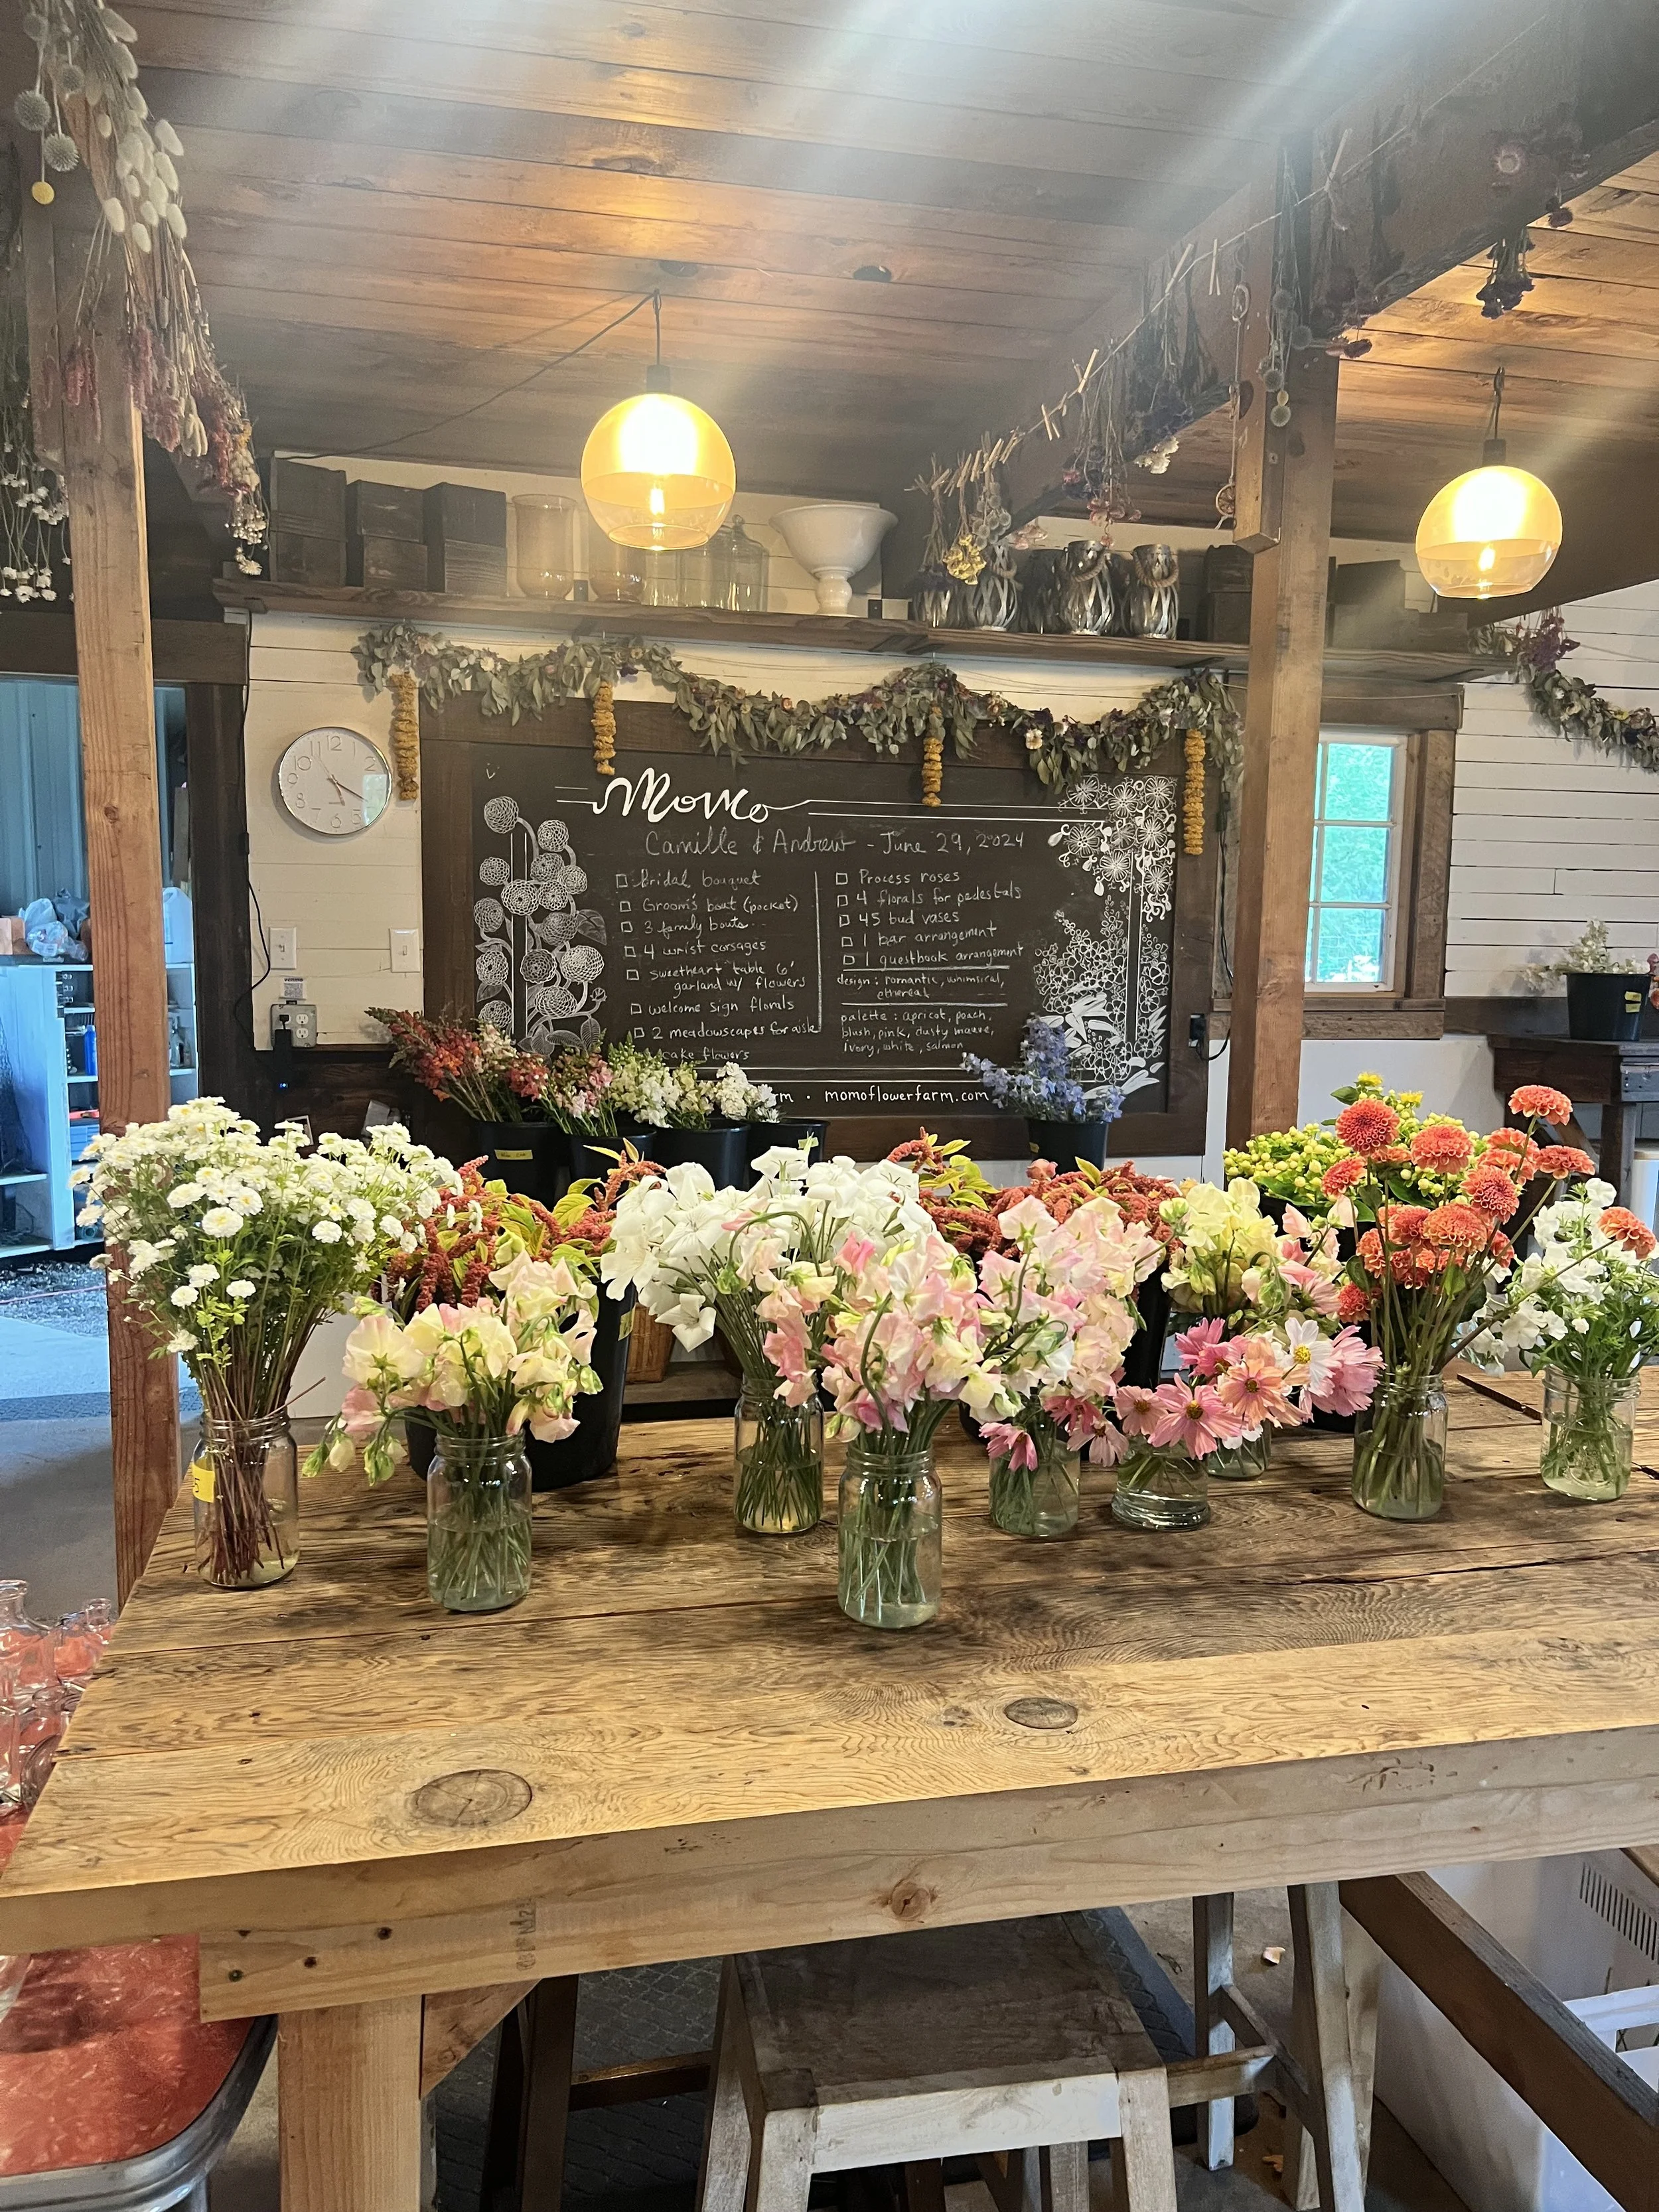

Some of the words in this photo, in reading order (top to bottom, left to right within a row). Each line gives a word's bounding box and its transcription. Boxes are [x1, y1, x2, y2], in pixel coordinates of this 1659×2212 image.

[310, 741, 321, 757] 11
[327, 735, 342, 751] 12
[294, 755, 312, 771] 10
[295, 792, 306, 808] 8
[646, 826, 737, 856] Camille
[772, 826, 856, 855] Andrew
[880, 832, 926, 855] June
[937, 833, 972, 855] 29,
[978, 830, 1024, 849] 2024
[703, 869, 762, 890] bouquet
[859, 869, 911, 884] Process
[920, 871, 960, 883] roses
[856, 891, 867, 905] 4
[877, 889, 923, 906] florals
[932, 889, 950, 904] for
[956, 881, 1021, 905] pedestals
[643, 894, 697, 913] Groom's
[707, 896, 737, 912] bout
[743, 894, 798, 913] (pocket)
[644, 921, 652, 933] 3
[658, 915, 703, 938] family
[859, 912, 880, 925] 45
[889, 910, 914, 924] bud
[921, 911, 959, 924] vases
[879, 931, 906, 946] bar
[915, 921, 997, 946] arrangement
[644, 944, 654, 960] 4
[663, 941, 705, 955] wrist
[711, 940, 766, 956] corsages
[879, 949, 948, 971] guestbook
[956, 942, 1024, 966] arrangement
[650, 964, 722, 980] sweetheart
[733, 961, 765, 974] table
[674, 977, 722, 998] garland
[755, 977, 806, 988] flowers
[649, 1002, 700, 1015] welcome
[751, 995, 795, 1011] florals
[652, 1027, 664, 1039] 2
[670, 1021, 764, 1038] meadowscapes
[770, 1022, 788, 1035] for
[879, 1025, 910, 1040] pink,
[915, 1026, 948, 1041] dusty
[664, 1048, 694, 1059] cake
[703, 1047, 749, 1062] flowers
[926, 1041, 963, 1052] salmon
[825, 1085, 989, 1103] momoflowerfarm.com
